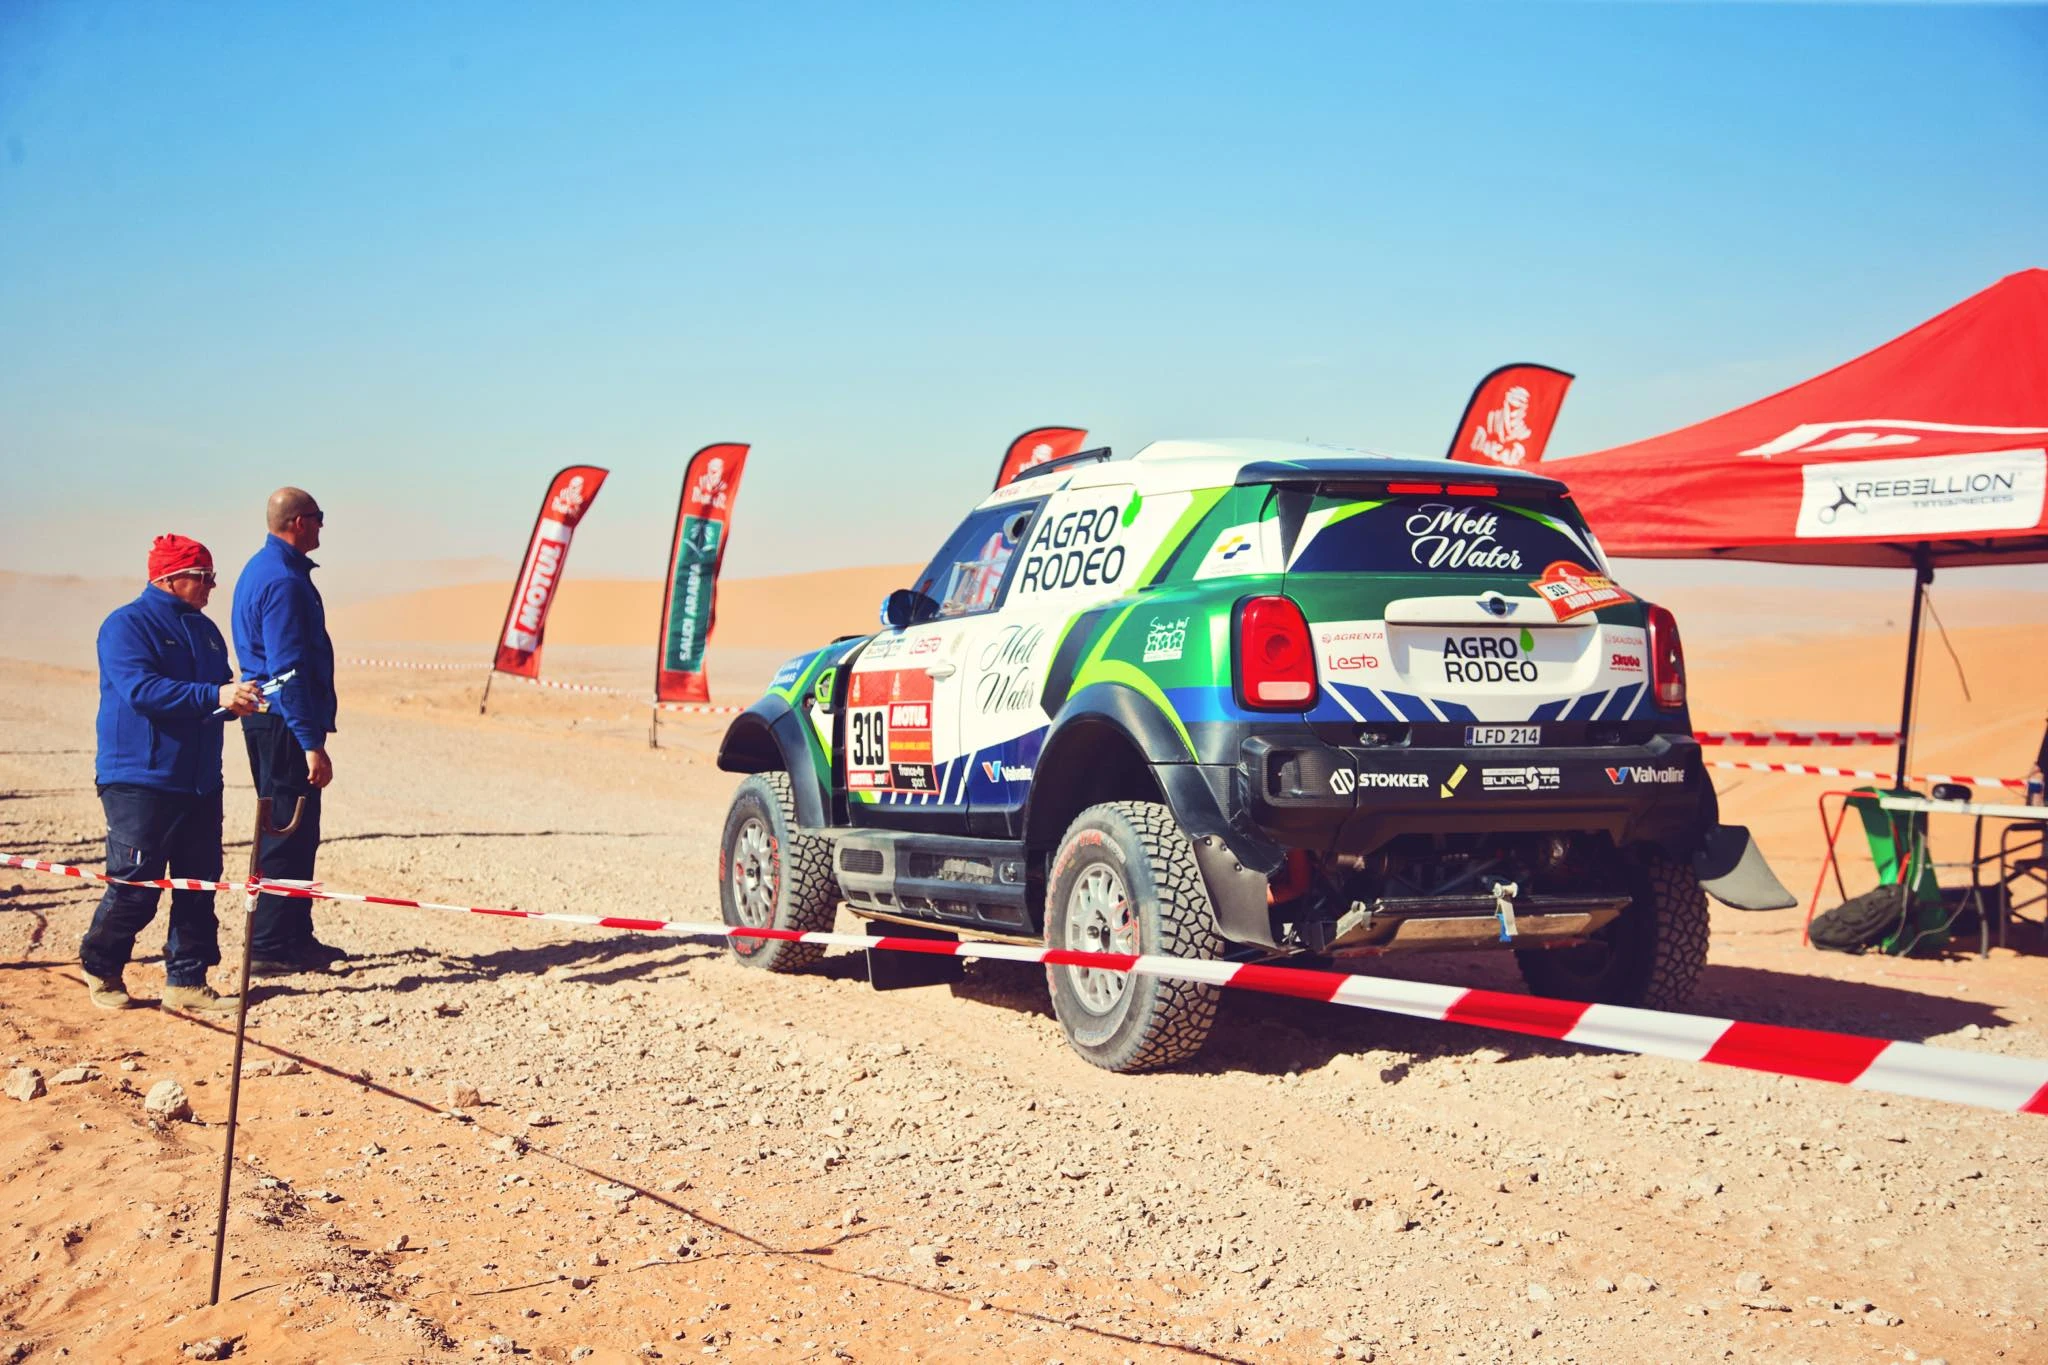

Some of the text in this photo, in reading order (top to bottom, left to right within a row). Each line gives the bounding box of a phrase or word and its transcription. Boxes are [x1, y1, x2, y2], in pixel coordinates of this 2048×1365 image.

[1031, 505, 1120, 552] AGRO
[1406, 503, 1499, 536] Melt
[1411, 535, 1523, 570] Water
[1019, 545, 1126, 593] RODEO
[518, 543, 562, 629] MOTUL
[980, 623, 1044, 671] Melt
[1332, 632, 1384, 642] AGRENTA
[1443, 637, 1518, 659] AGRO
[1328, 653, 1379, 671] Lesta
[1444, 660, 1538, 683] RODEO
[891, 705, 929, 727] MOTUL
[853, 711, 884, 766] 319
[1475, 728, 1538, 744] LFD 214
[1358, 773, 1429, 788] STOKKER
